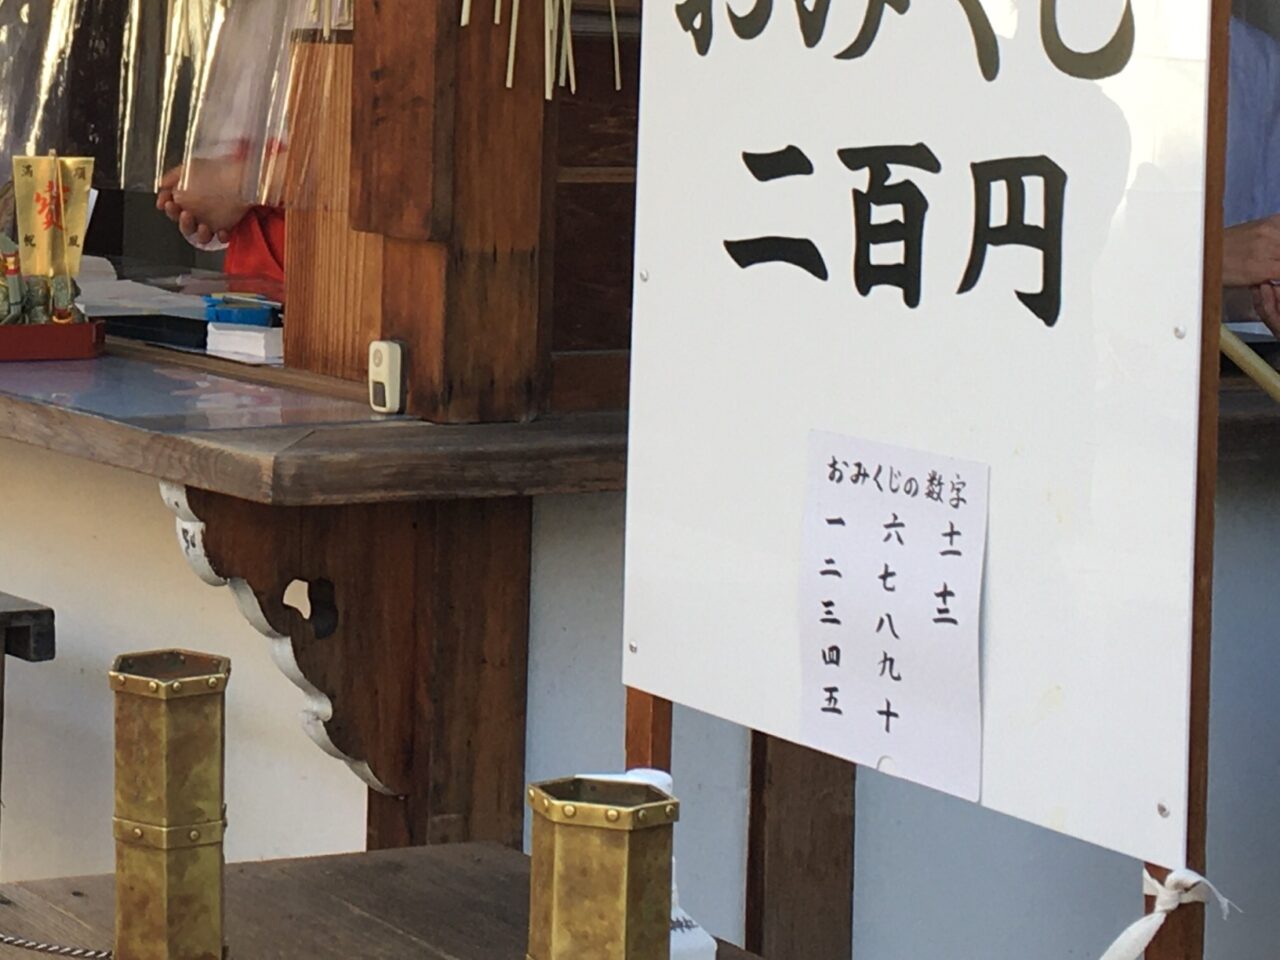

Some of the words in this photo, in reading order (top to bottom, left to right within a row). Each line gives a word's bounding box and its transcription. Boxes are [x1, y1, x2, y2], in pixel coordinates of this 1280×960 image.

[723, 142, 1068, 327] 二百円
[827, 455, 967, 509] おみくじの数字
[825, 517, 846, 527] 一
[882, 512, 906, 546] 六
[939, 521, 963, 557] 十一
[819, 558, 842, 578] 二
[877, 563, 897, 592] 七
[819, 600, 842, 625] 三
[932, 582, 959, 626] 十二
[875, 612, 900, 640] 八
[821, 645, 841, 666] 四
[878, 650, 902, 682] 九
[820, 686, 843, 715] 五
[876, 698, 900, 734] 十
